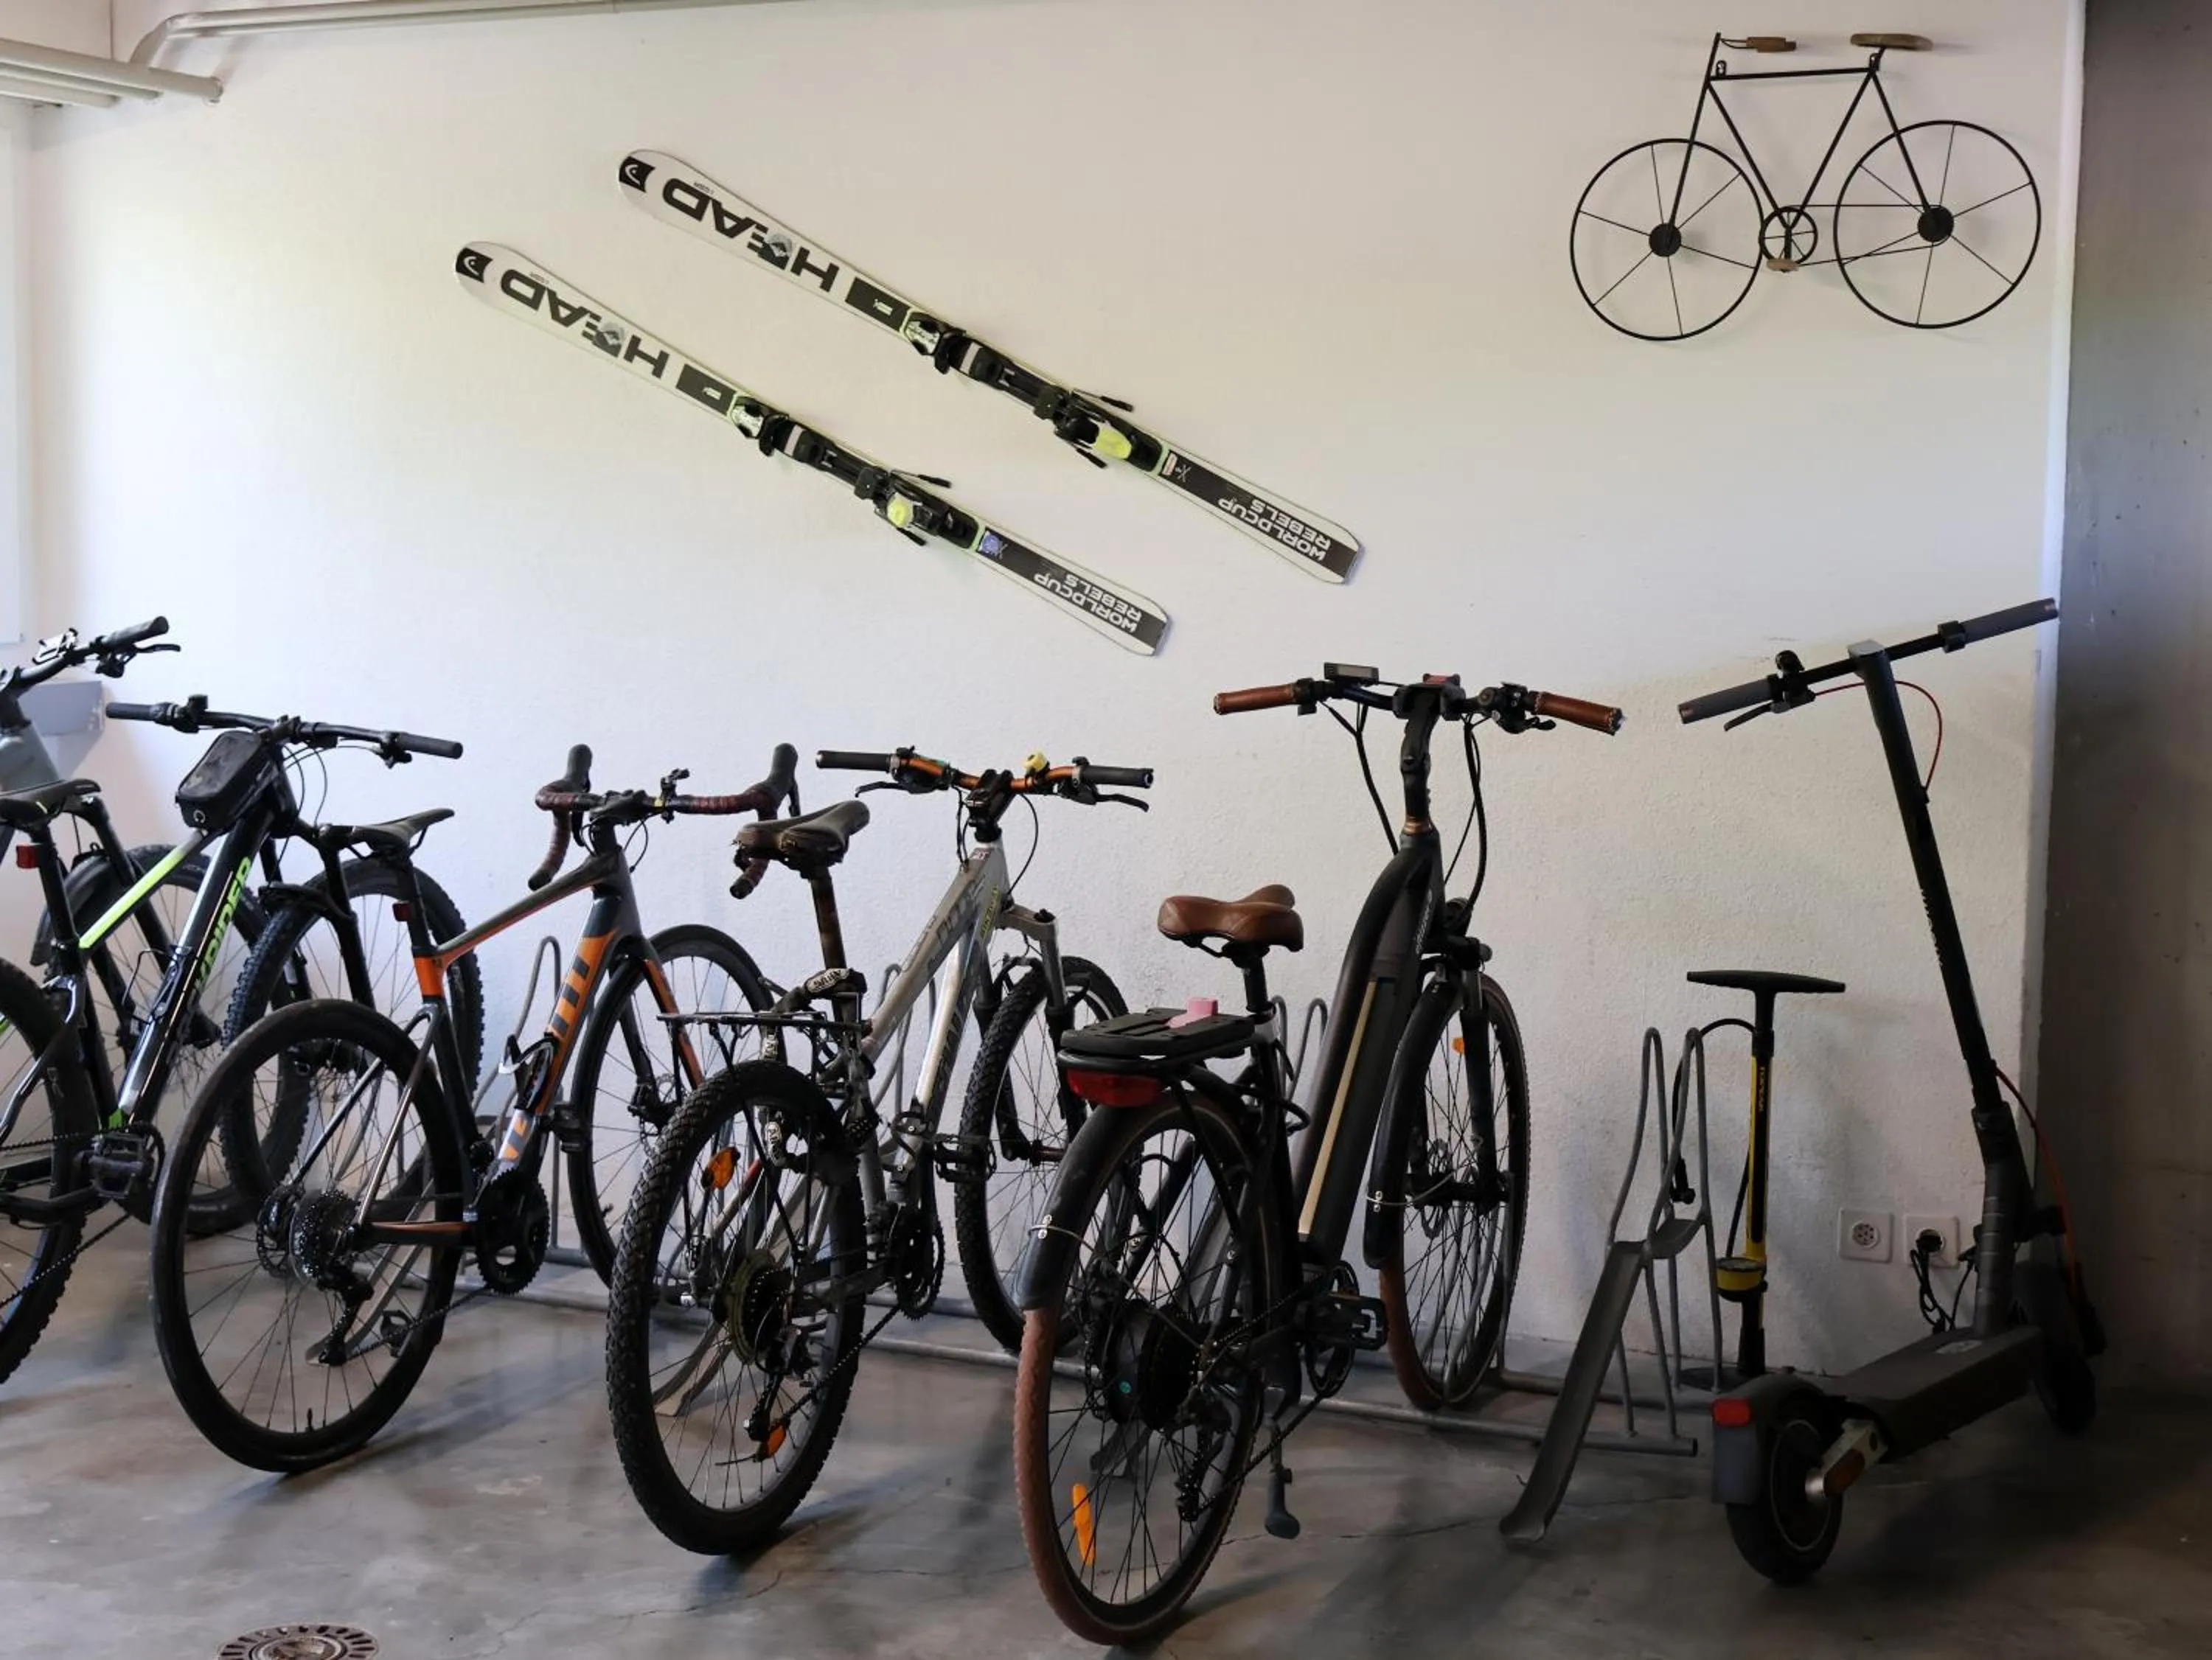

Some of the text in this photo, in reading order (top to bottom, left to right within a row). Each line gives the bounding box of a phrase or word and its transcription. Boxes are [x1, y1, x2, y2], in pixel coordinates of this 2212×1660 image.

[1217, 498, 1327, 562] WORLDCUP
[1251, 498, 1332, 551] REBELS
[1034, 573, 1138, 633] WORLDCUP
[1065, 573, 1143, 623] REBELS
